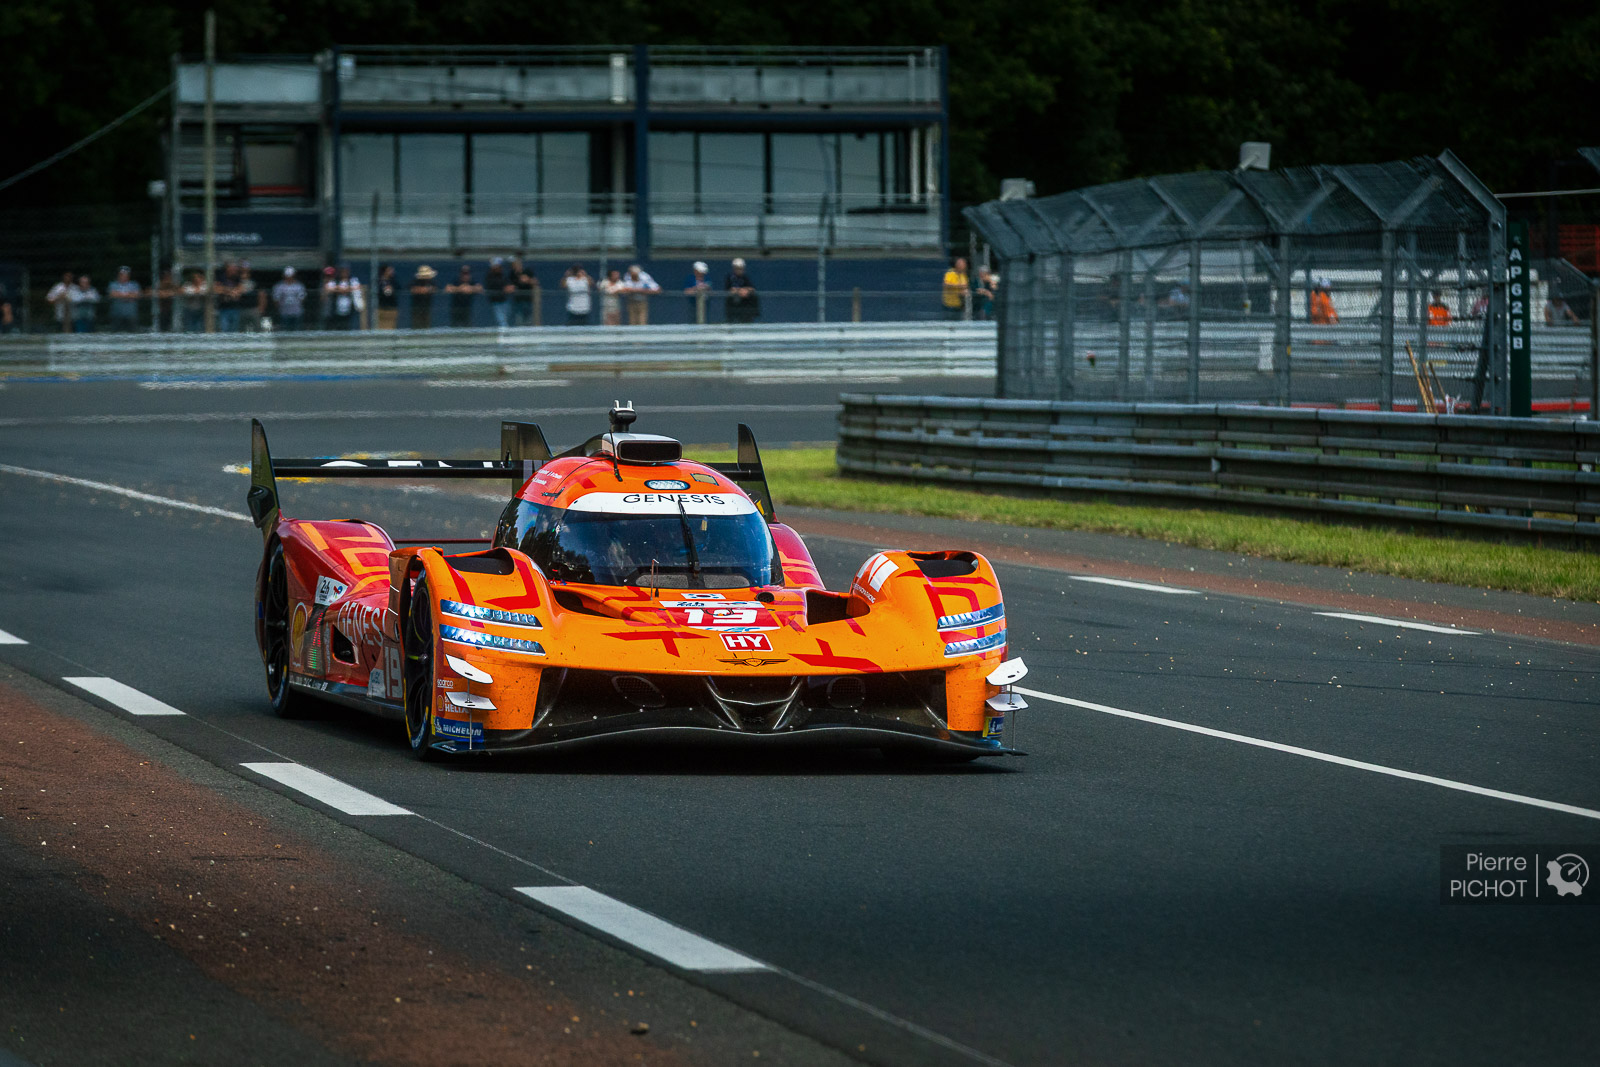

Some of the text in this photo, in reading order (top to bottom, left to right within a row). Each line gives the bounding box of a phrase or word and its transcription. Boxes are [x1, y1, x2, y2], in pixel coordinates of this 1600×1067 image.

[622, 493, 726, 506] GENESIS
[337, 600, 388, 647] GENESI
[684, 608, 758, 625] 19
[725, 635, 763, 648] HY
